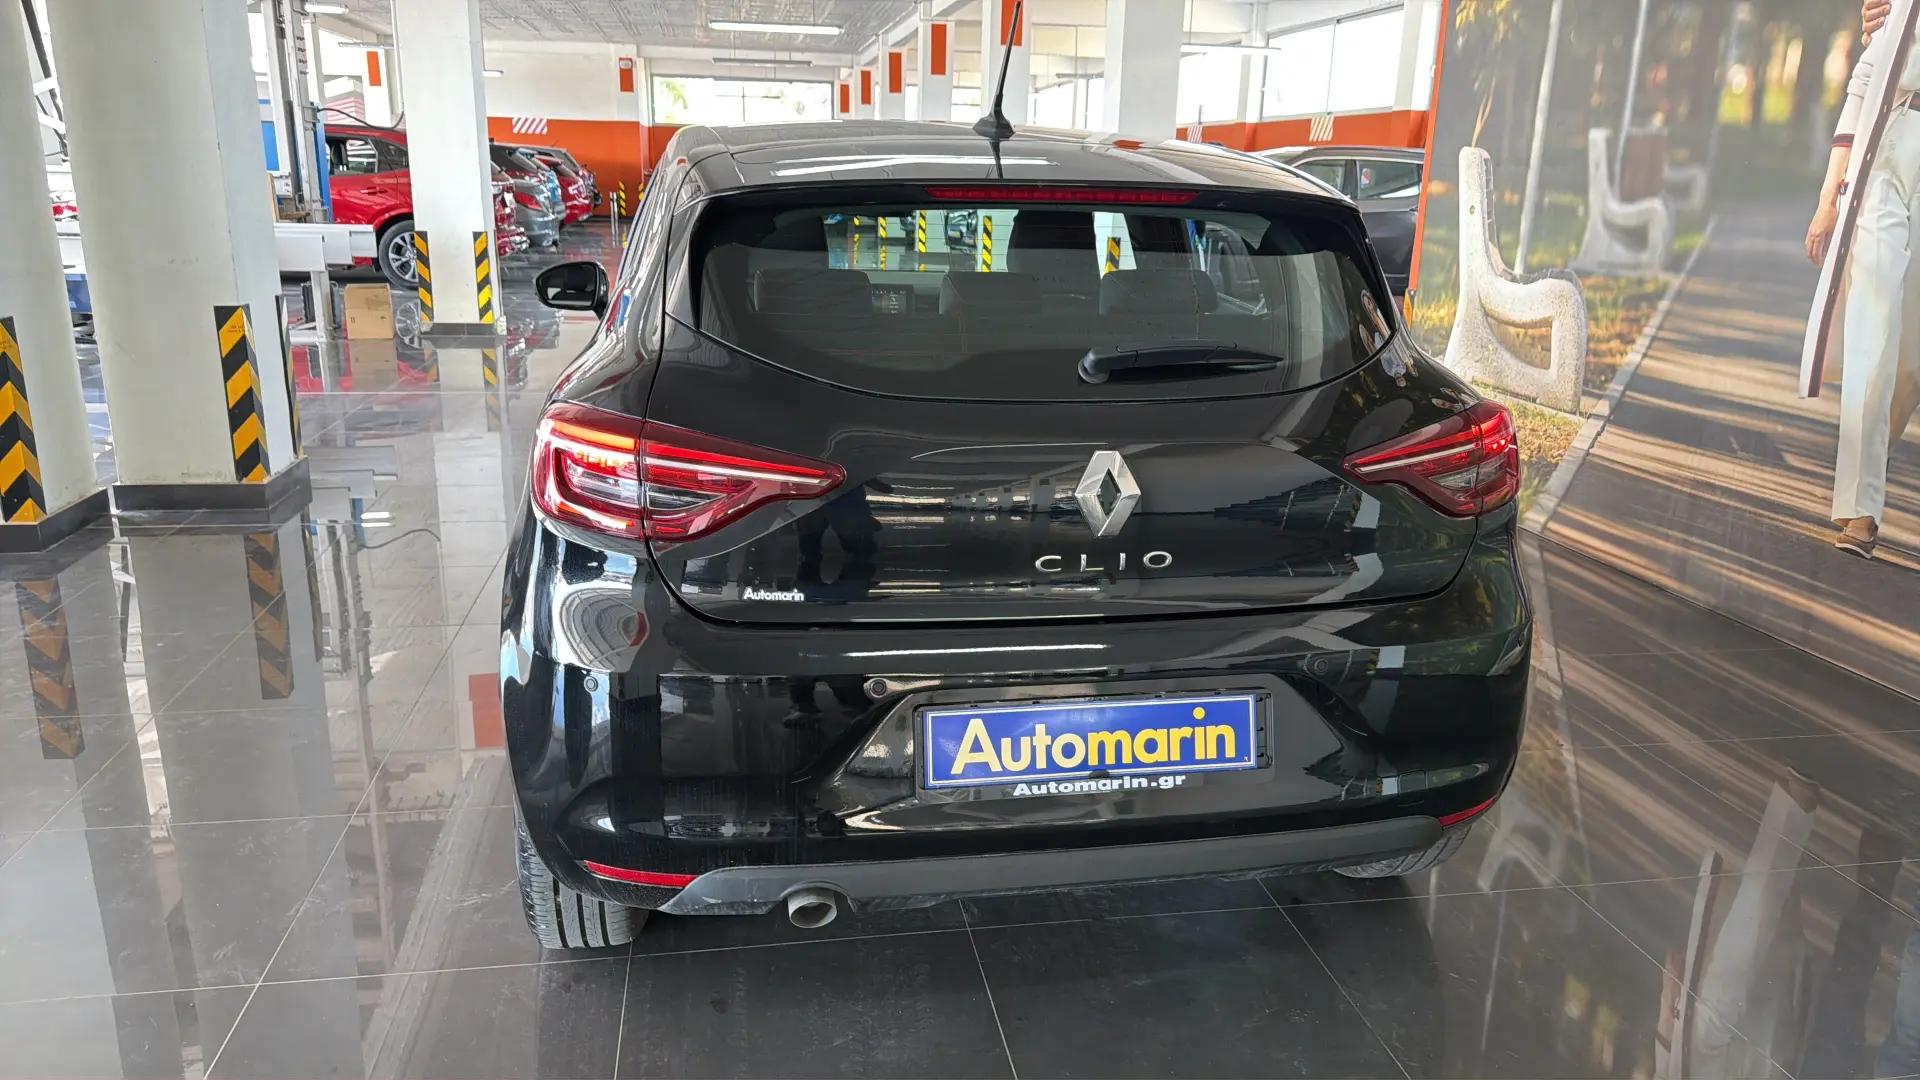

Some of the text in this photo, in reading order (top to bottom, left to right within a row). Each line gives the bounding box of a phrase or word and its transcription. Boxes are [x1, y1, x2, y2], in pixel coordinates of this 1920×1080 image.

[1035, 550, 1173, 573] CLIO
[743, 586, 805, 601] Automarin
[950, 706, 1236, 775] Automarin
[1012, 774, 1187, 797] Automarin.gr
